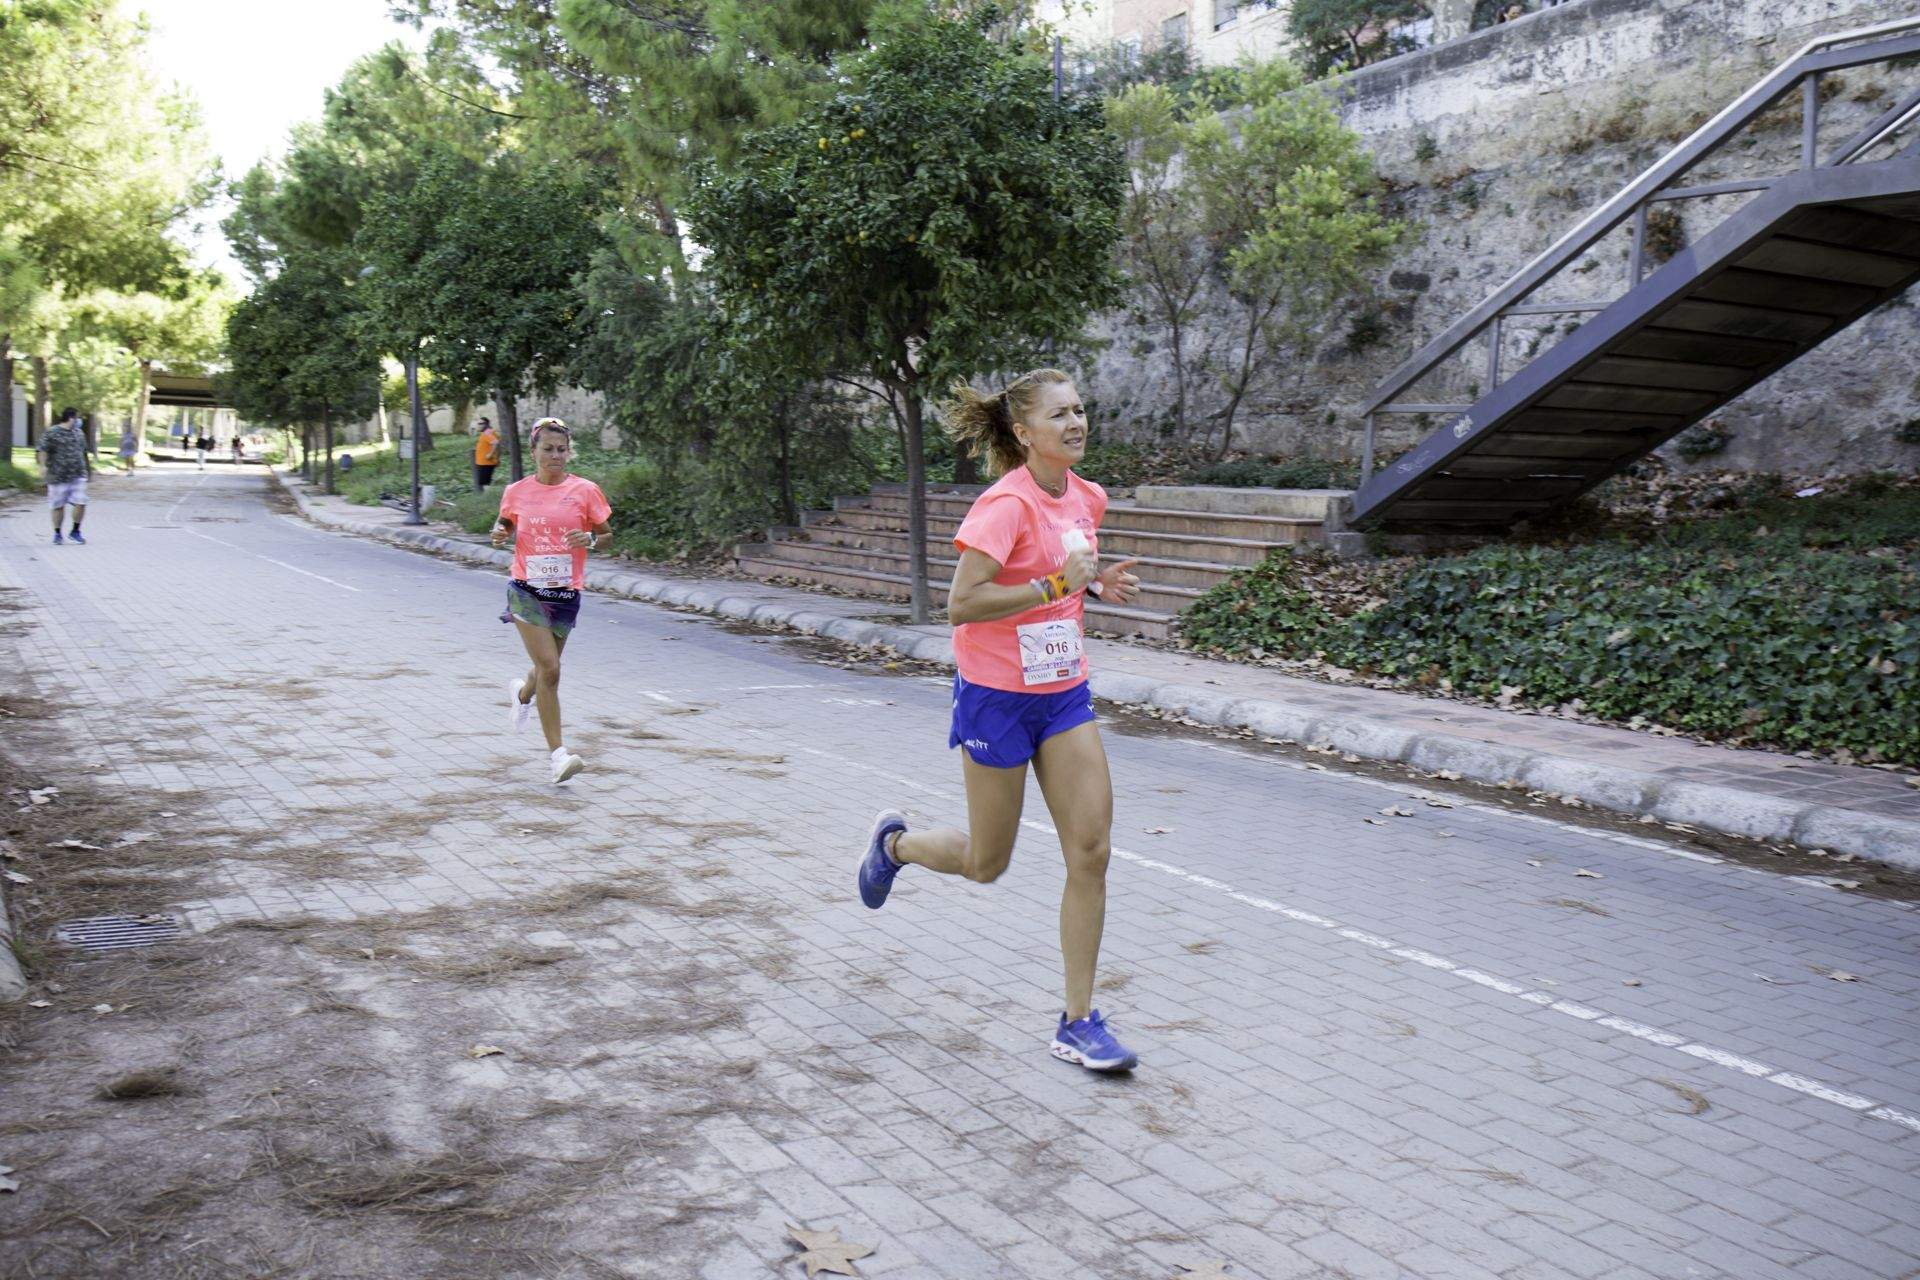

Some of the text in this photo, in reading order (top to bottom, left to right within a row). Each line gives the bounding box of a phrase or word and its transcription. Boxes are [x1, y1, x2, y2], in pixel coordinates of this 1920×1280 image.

[529, 517, 547, 525] WE
[541, 565, 559, 574] 016
[1045, 641, 1068, 655] 016
